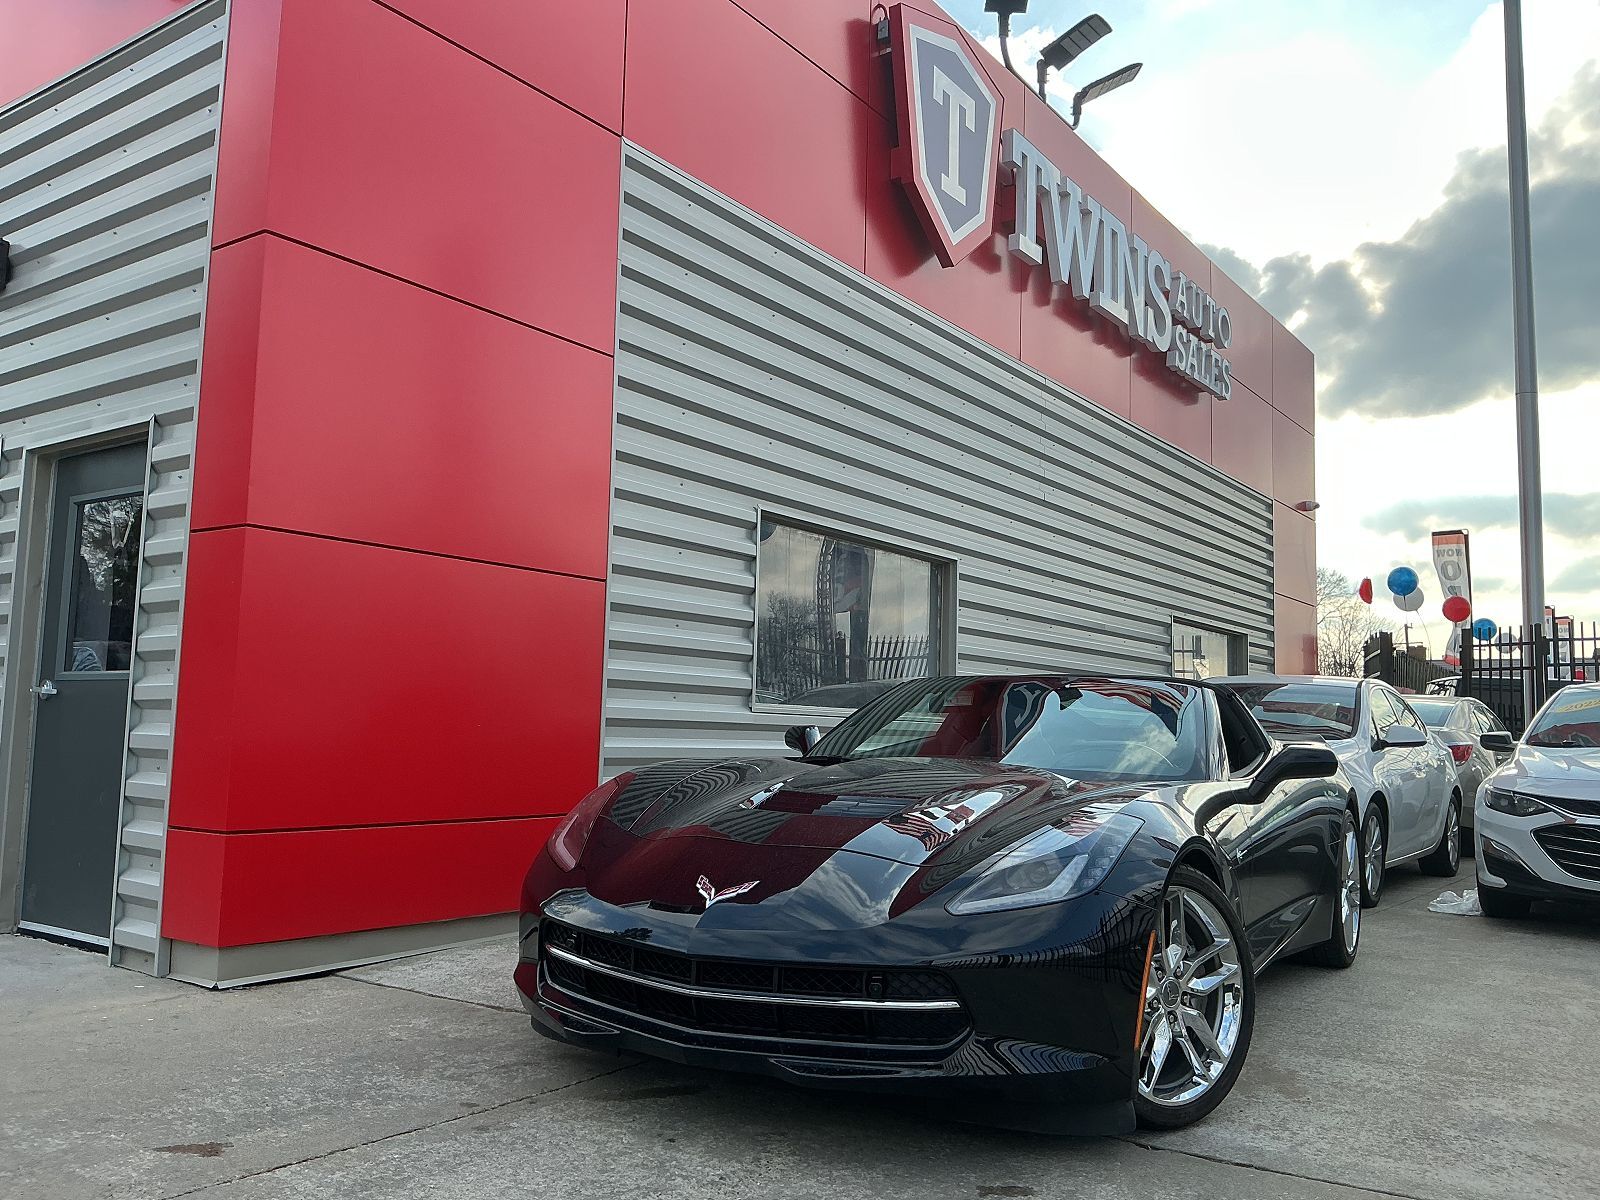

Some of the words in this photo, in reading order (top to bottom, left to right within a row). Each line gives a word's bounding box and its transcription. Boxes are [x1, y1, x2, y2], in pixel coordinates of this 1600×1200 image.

[933, 65, 976, 206] T
[1003, 128, 1171, 352] TWINS
[1166, 325, 1232, 400] SALES
[1171, 271, 1232, 349] AUTO
